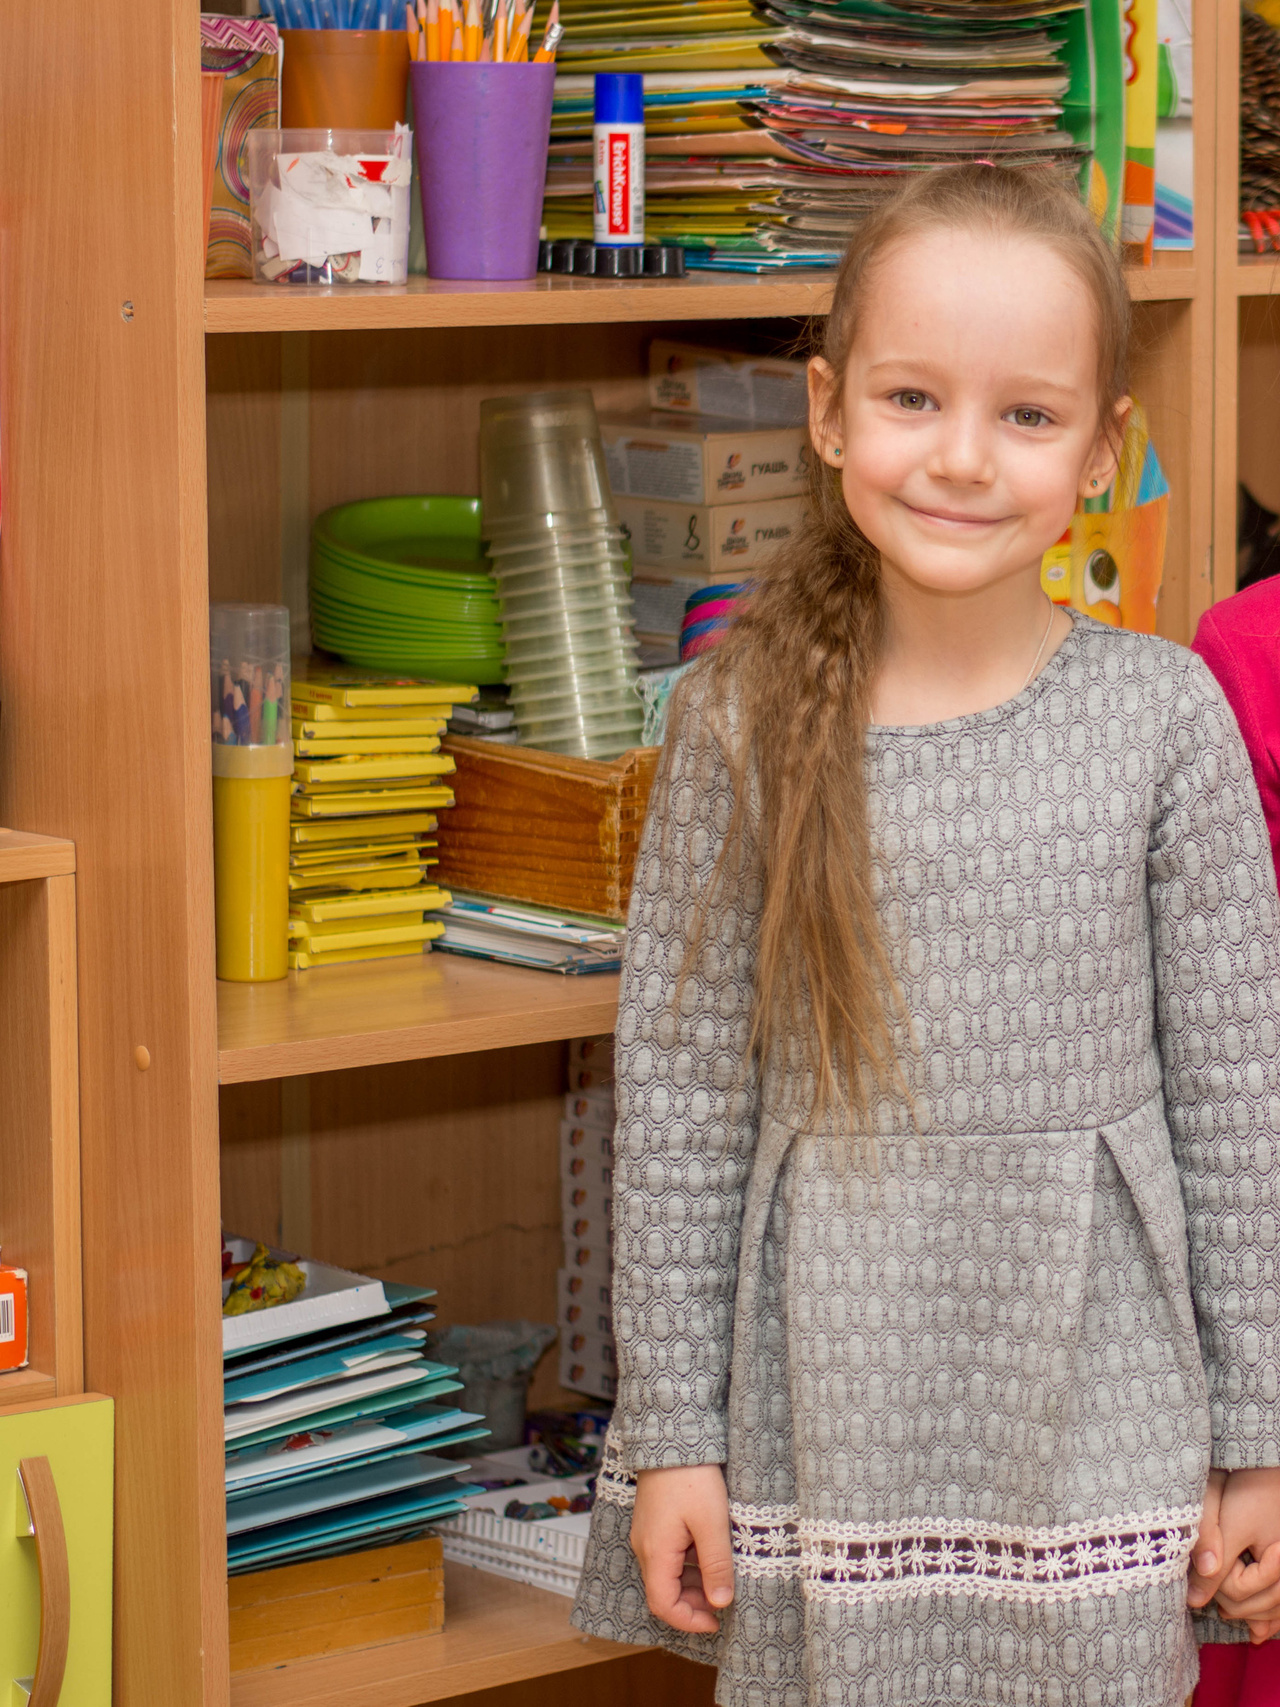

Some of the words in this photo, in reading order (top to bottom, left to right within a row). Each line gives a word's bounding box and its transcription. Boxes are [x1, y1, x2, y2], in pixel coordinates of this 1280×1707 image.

[612, 140, 626, 226] ErichKrause
[751, 461, 788, 476] ГУАШЬ
[684, 514, 700, 551] 8
